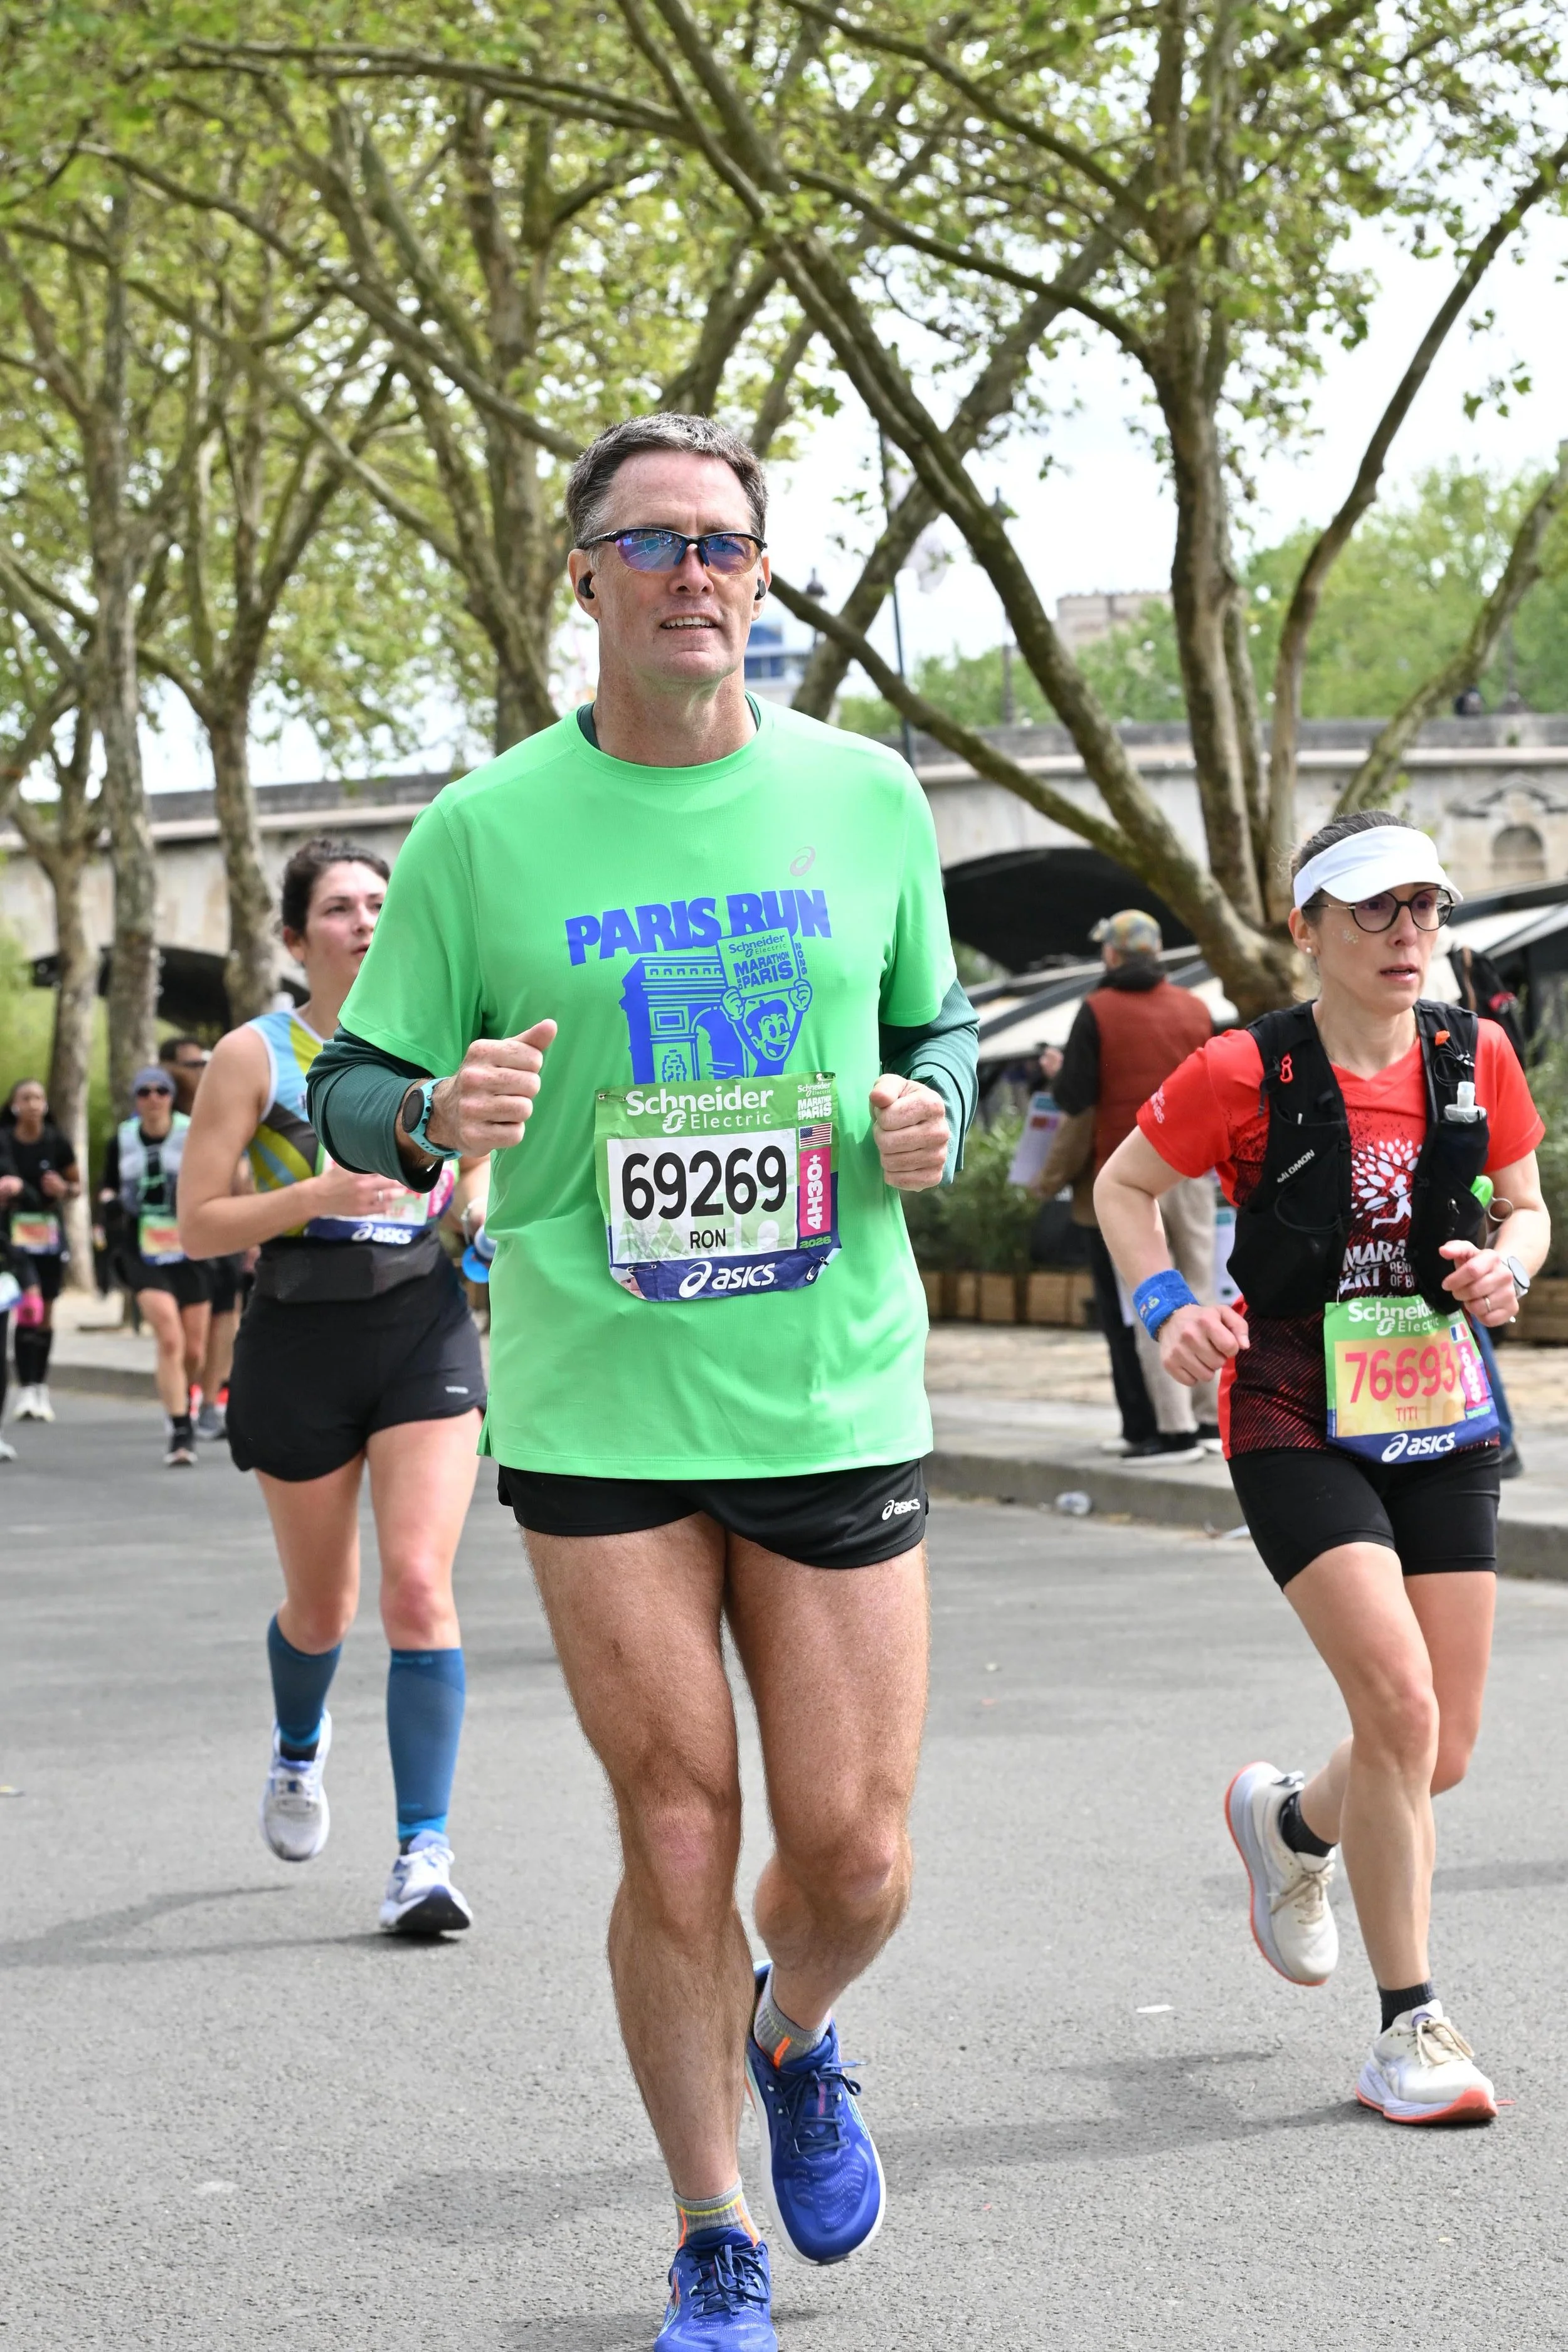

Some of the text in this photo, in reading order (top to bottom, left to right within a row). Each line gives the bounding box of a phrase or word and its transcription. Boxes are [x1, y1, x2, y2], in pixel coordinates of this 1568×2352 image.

[564, 889, 832, 966] PARIS RUN
[729, 935, 785, 953] Schneider
[755, 944, 787, 955] Electric
[733, 951, 790, 978] MARATHON
[795, 942, 807, 975] 2026
[742, 960, 793, 989] PARIS
[627, 1085, 774, 1116] Schneider
[797, 1081, 832, 1093] Schneider
[691, 1111, 772, 1130] Electric
[801, 1102, 832, 1120] PARIS
[622, 1145, 787, 1221] 69269
[807, 1154, 824, 1230] 4H30+
[690, 1229, 726, 1249] RON
[1342, 1239, 1406, 1271] MARA
[1348, 1300, 1435, 1323] Schneid
[1345, 1341, 1456, 1404] 76693
[1396, 1406, 1418, 1422] TITI
